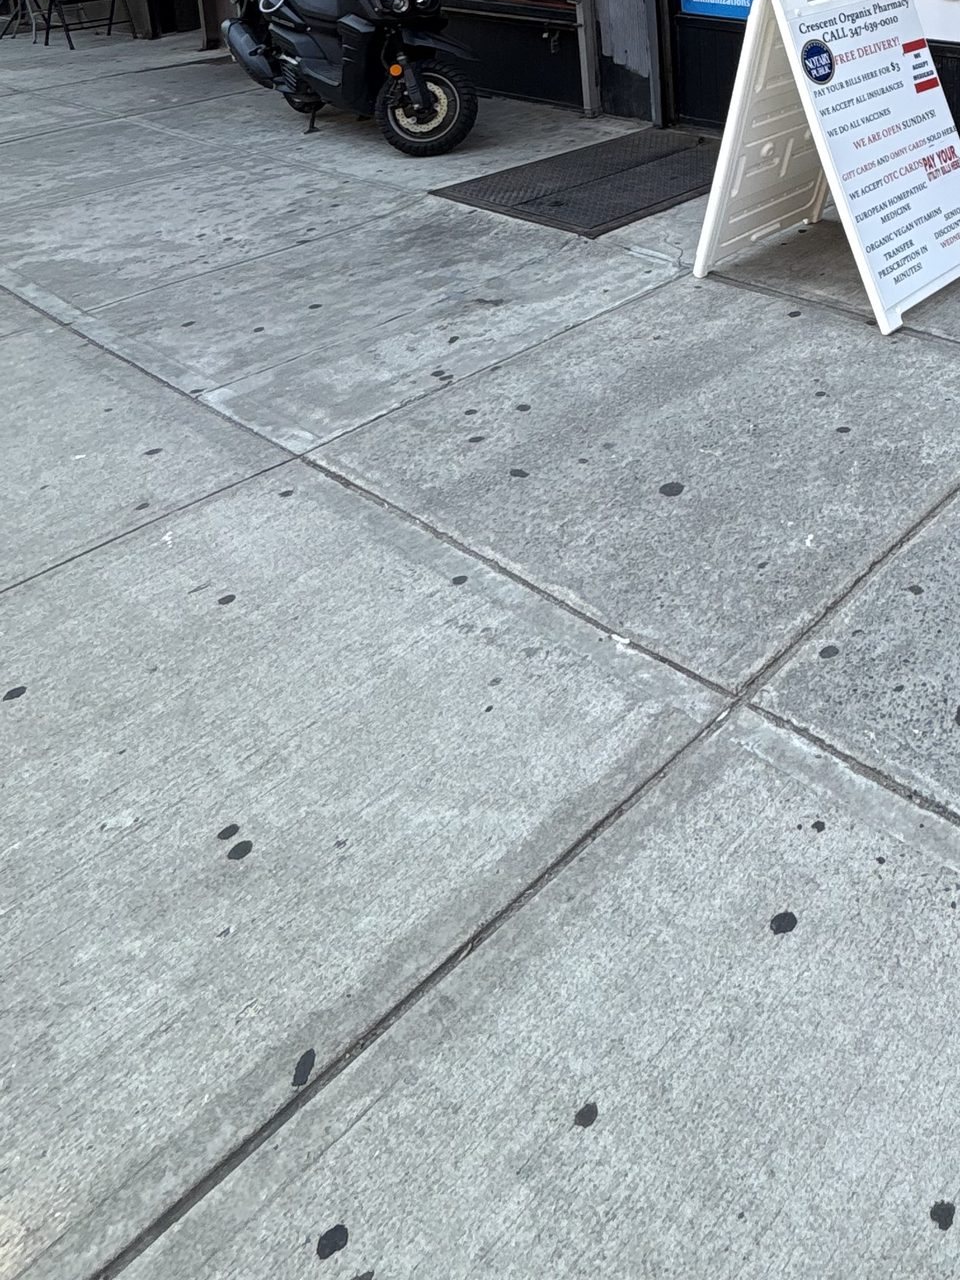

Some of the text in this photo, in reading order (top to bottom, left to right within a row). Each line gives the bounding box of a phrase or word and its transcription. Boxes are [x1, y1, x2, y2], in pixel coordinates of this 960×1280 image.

[799, 16, 838, 34] Crescent
[838, 7, 873, 25] Organix
[822, 16, 899, 44] CALL 347-639-0010
[805, 52, 831, 69] NOTARY
[834, 37, 900, 66] FREE DELIVERY!
[810, 64, 832, 78] PUBLIC
[814, 62, 901, 99] PAY YOUR BILLS HERE FOR $3
[819, 81, 904, 117] WE ACCEPT ALL INSURANCES
[827, 107, 892, 138] WE DO ALL VACCINES
[853, 109, 937, 150] WE ARE OPEN SUNDAYS!
[842, 171, 855, 182] GIFT
[855, 161, 877, 176] CARDS
[876, 155, 890, 166] AND
[908, 139, 927, 152] CARDS
[926, 132, 942, 144] SOLD
[941, 125, 957, 138] HERE
[922, 145, 958, 172] PAY YOUR
[849, 160, 923, 201] WE ACCEPT OTC CARDS
[854, 181, 928, 224] EUROPEAN HOMEPATHIC
[880, 203, 911, 224] MEDICINE
[865, 207, 943, 254] ORGANIC VEGAN VITAMINS
[878, 247, 921, 279] PRESCRIPTION
[883, 239, 915, 261] TRANSFER
[893, 261, 923, 285] MINUTES!
